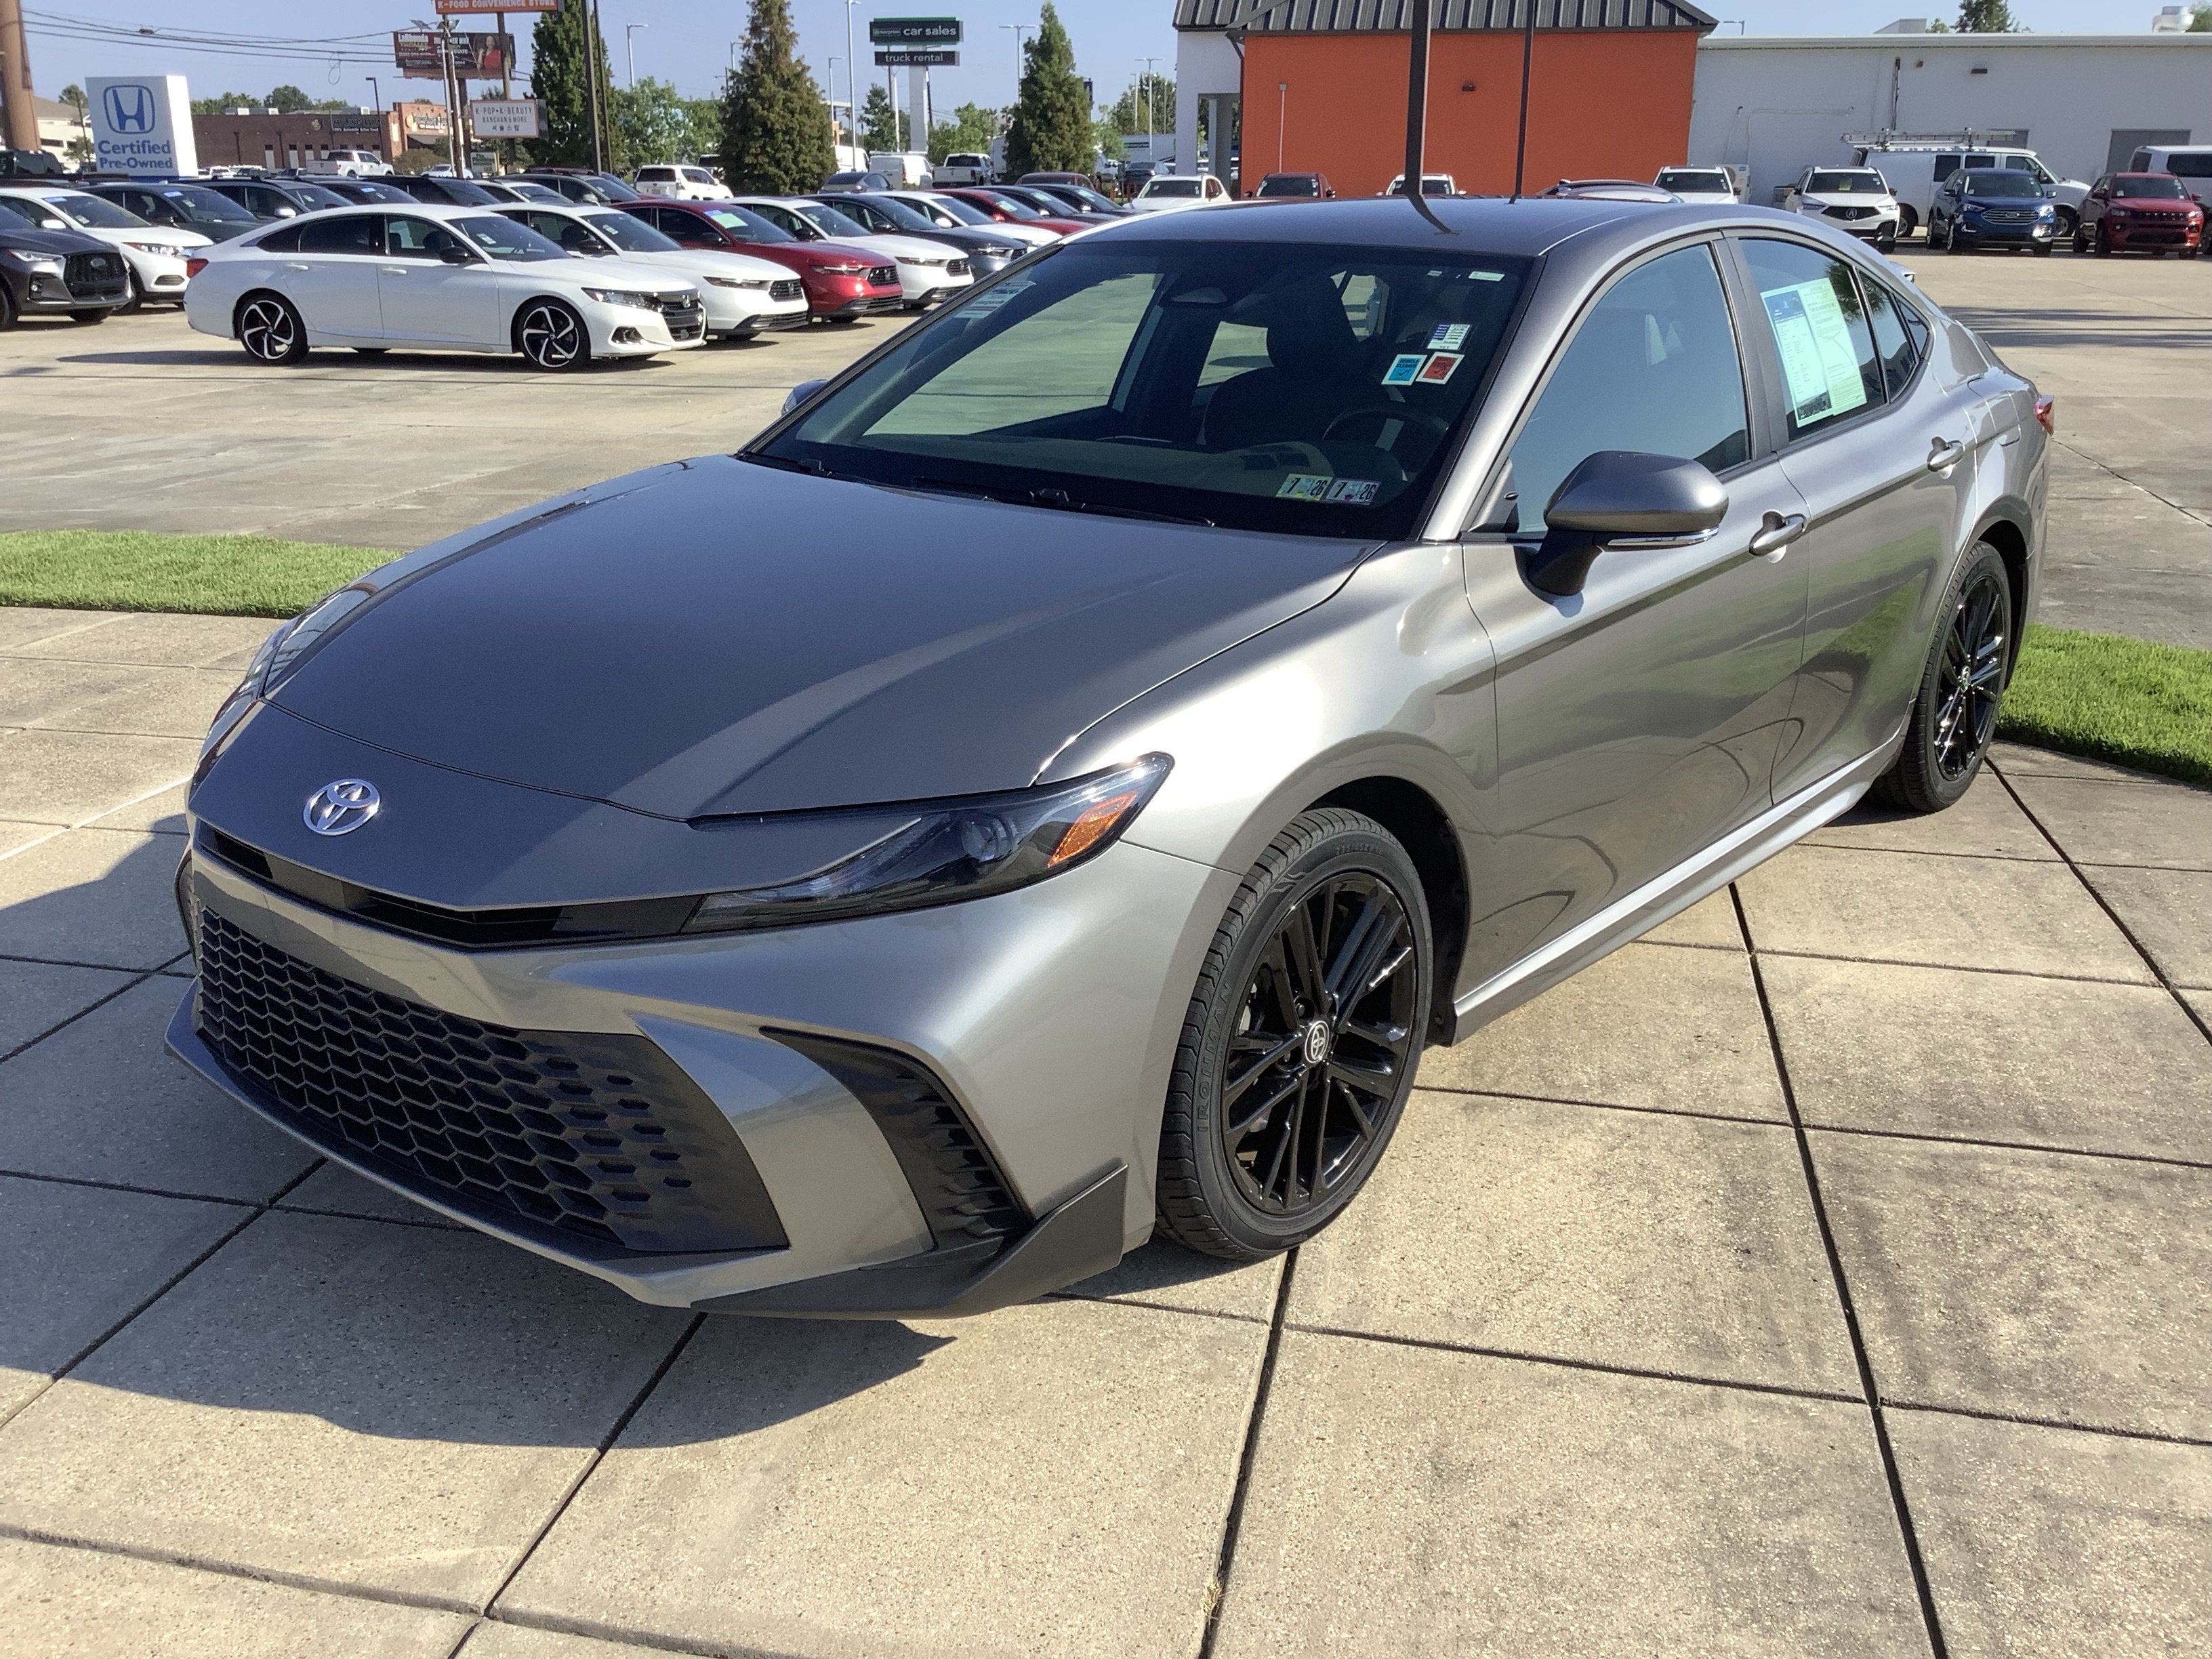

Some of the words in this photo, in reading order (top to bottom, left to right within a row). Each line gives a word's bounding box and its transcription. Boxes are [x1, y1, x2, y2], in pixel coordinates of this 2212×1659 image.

[438, 1, 469, 9] K-FOOD
[472, 0, 526, 8] CONVENIENCE
[903, 28, 923, 36] car
[925, 26, 956, 35] sales
[885, 53, 911, 62] truck
[914, 53, 943, 62] rental
[98, 140, 171, 154] Certified
[100, 157, 173, 168] Pre-Owned
[1287, 477, 1301, 493] 7
[1309, 480, 1328, 496] 26
[1333, 482, 1348, 498] 7
[1359, 483, 1376, 500] 26
[1197, 981, 1233, 1132] IRONMAN
